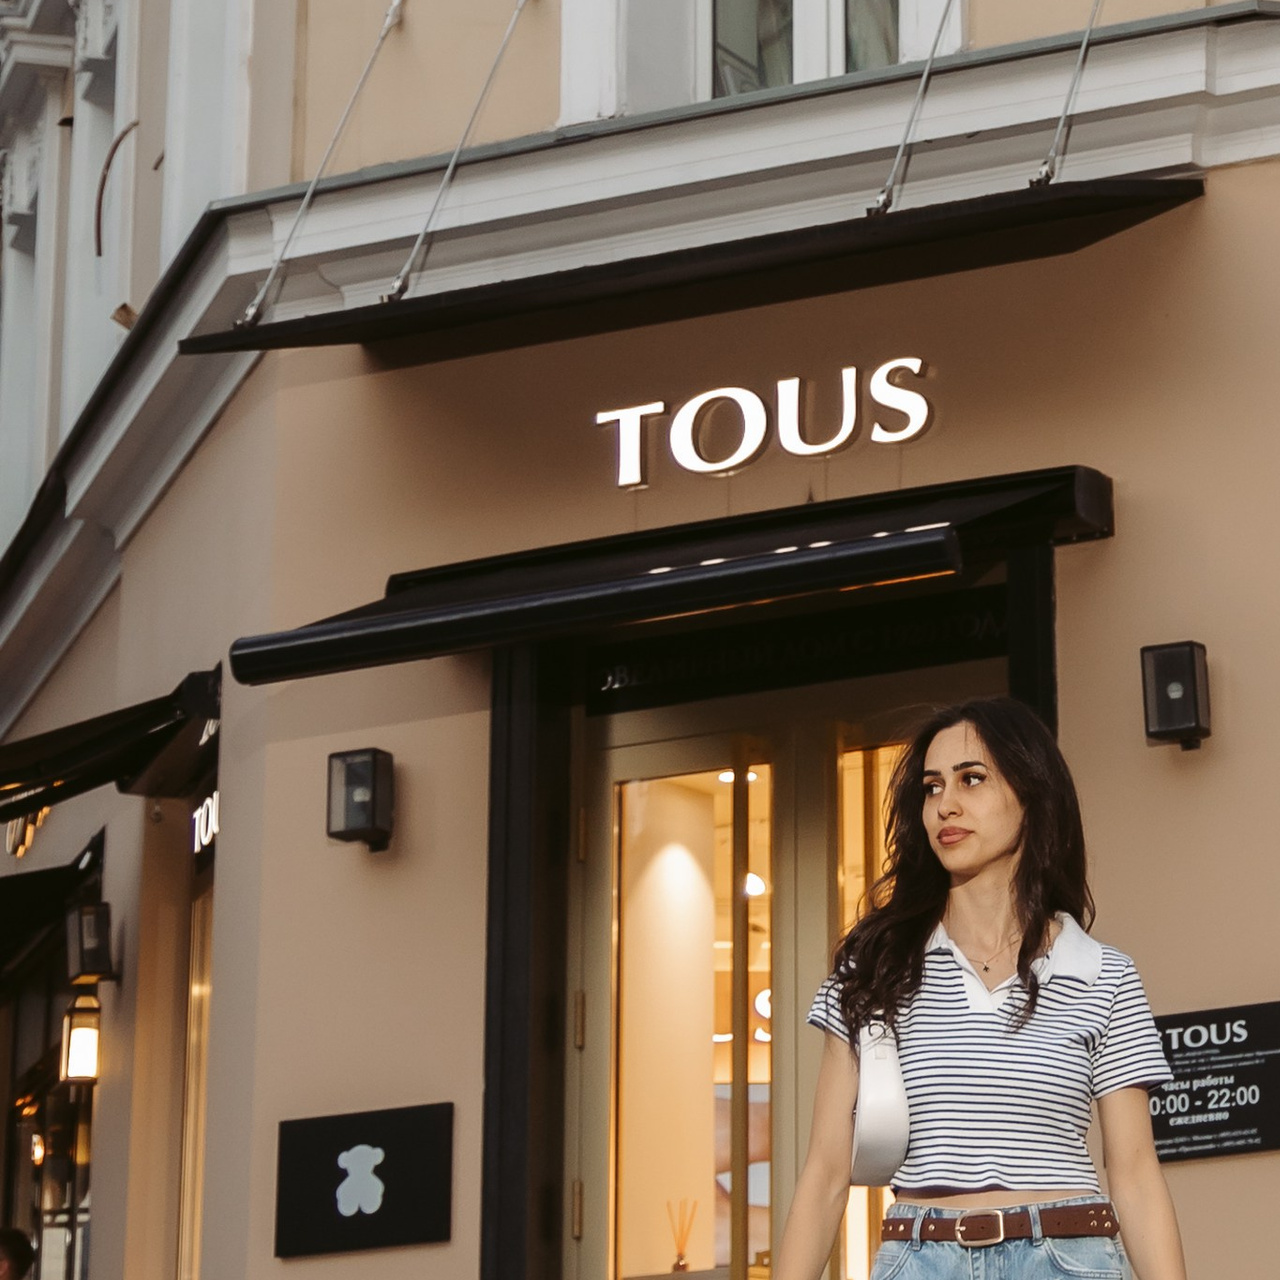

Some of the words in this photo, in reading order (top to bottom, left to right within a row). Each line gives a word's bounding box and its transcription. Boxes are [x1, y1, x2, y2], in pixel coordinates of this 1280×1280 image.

[596, 356, 929, 487] TOUS
[1166, 1020, 1249, 1050] TOUS
[1149, 1093, 1190, 1116] 0:00
[1207, 1084, 1260, 1110] 22:00
